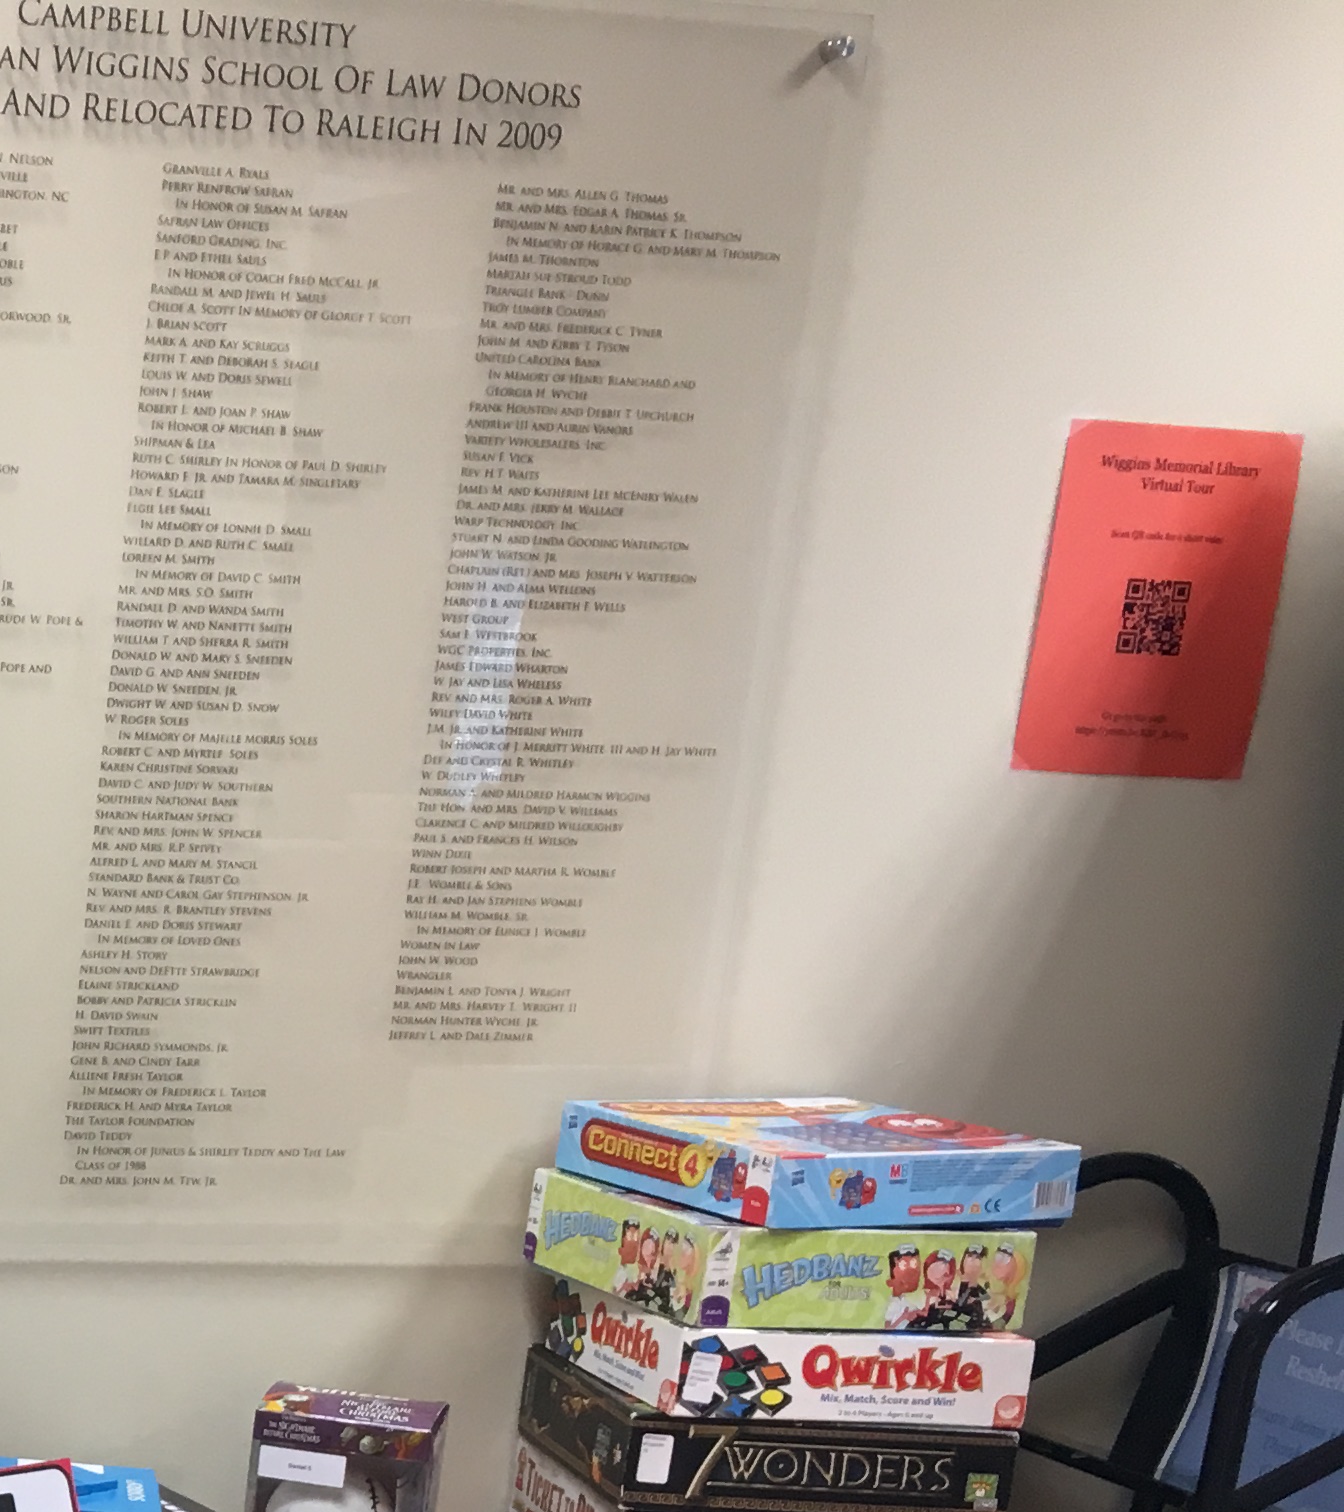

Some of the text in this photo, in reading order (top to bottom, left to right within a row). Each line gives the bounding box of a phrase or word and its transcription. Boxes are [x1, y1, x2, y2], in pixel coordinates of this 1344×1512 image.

[17, 0, 357, 48] CAMPBELL UNIVERSITY
[52, 44, 191, 83] WIGGINS
[200, 56, 323, 92] SCHOOL
[334, 65, 376, 95] OF
[386, 68, 446, 99] LAW
[457, 73, 583, 108] DONORS
[1, 89, 71, 119] AND
[82, 93, 252, 132] RELOCATED
[264, 105, 305, 134] TO
[316, 108, 441, 144] RALEIGH
[452, 118, 487, 147] IN
[497, 120, 564, 151] 2009
[1101, 454, 1262, 479] Wiggins Memorial Library
[1141, 477, 1215, 495] Virtual Tour
[683, 1155, 701, 1180] 4
[591, 1300, 660, 1372] Qwirkle
[801, 1344, 983, 1392] Qwirkle
[911, 1396, 931, 1406] and
[686, 1425, 954, 1499] 7 WONDERS
